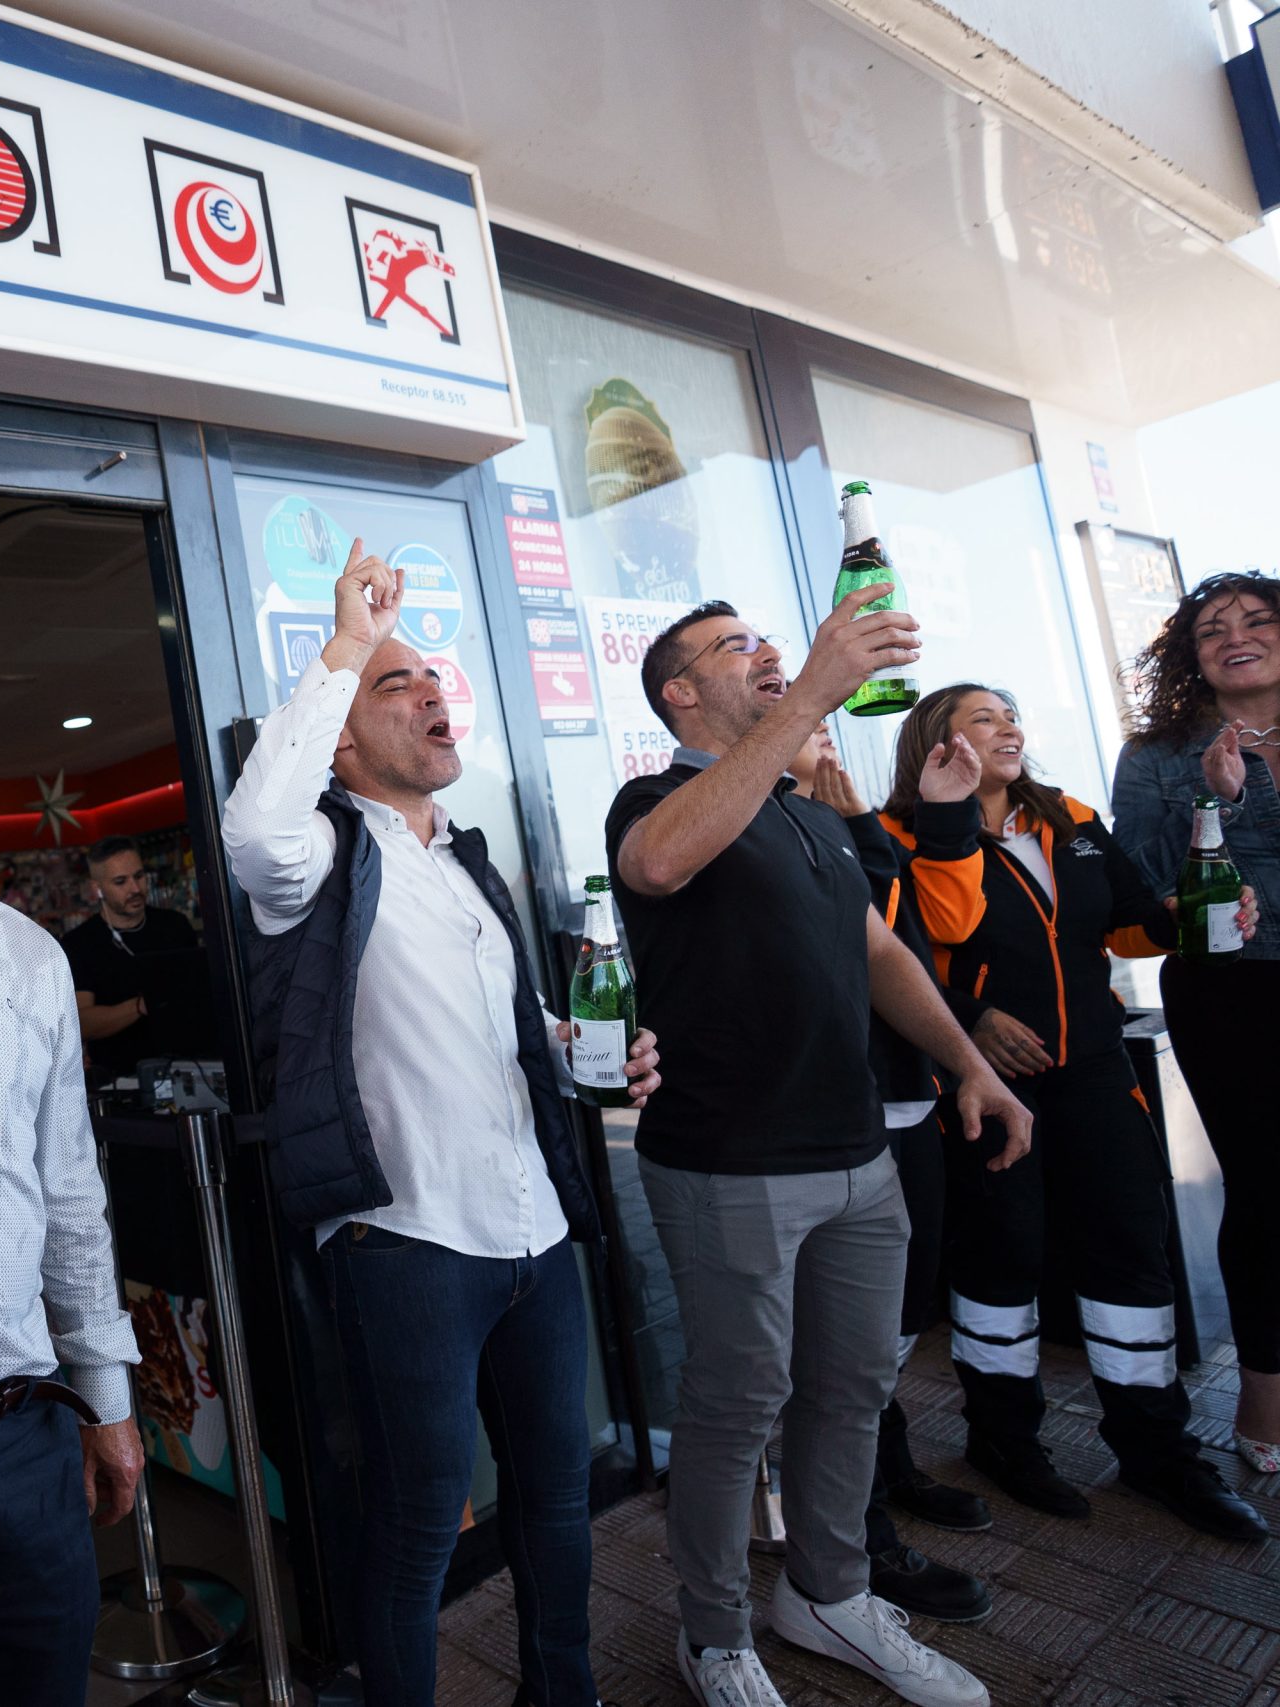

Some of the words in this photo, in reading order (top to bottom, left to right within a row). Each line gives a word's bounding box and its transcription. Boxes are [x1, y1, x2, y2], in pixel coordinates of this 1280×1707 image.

[381, 379, 429, 399] Receptor
[433, 389, 467, 406] 68.515
[511, 520, 558, 537] ALARMA
[512, 540, 564, 556] CONECTADA
[531, 560, 565, 575] HORAS
[601, 612, 612, 630] 5
[624, 732, 633, 750] 5
[638, 732, 674, 750] PRE
